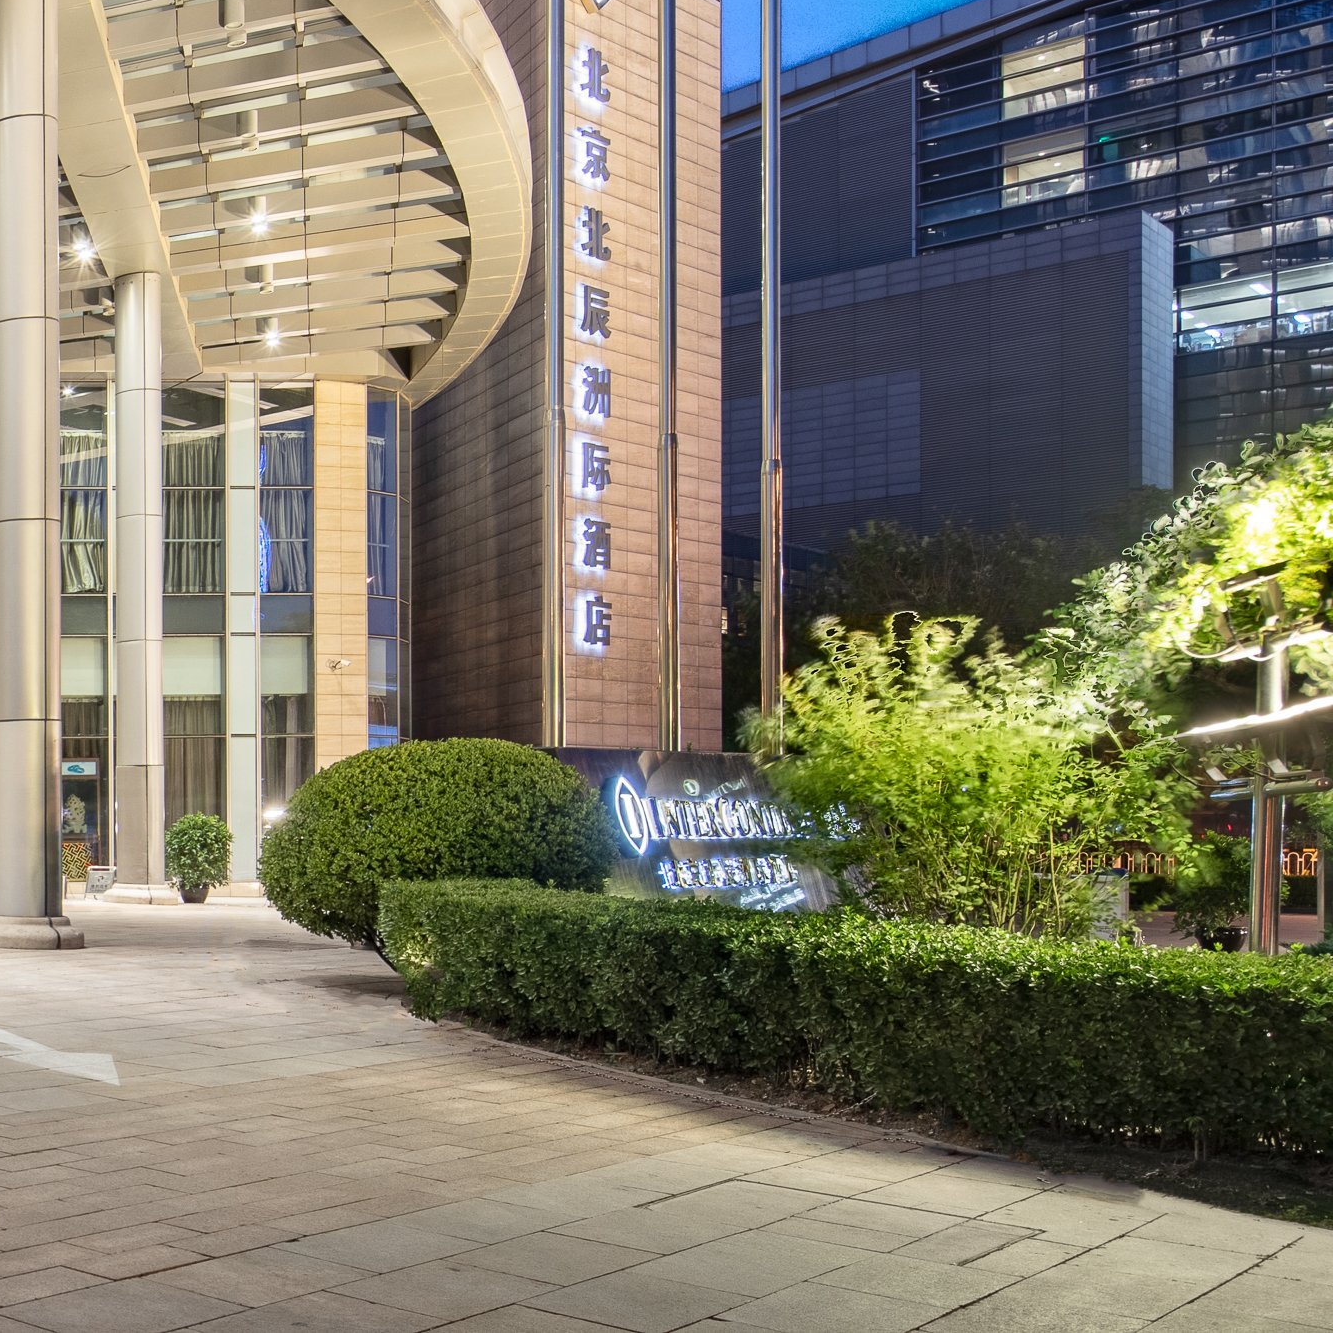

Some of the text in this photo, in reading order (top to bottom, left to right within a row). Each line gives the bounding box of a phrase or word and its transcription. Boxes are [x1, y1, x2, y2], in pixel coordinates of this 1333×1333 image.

[578, 47, 612, 646] 北京北辰洲际酒店
